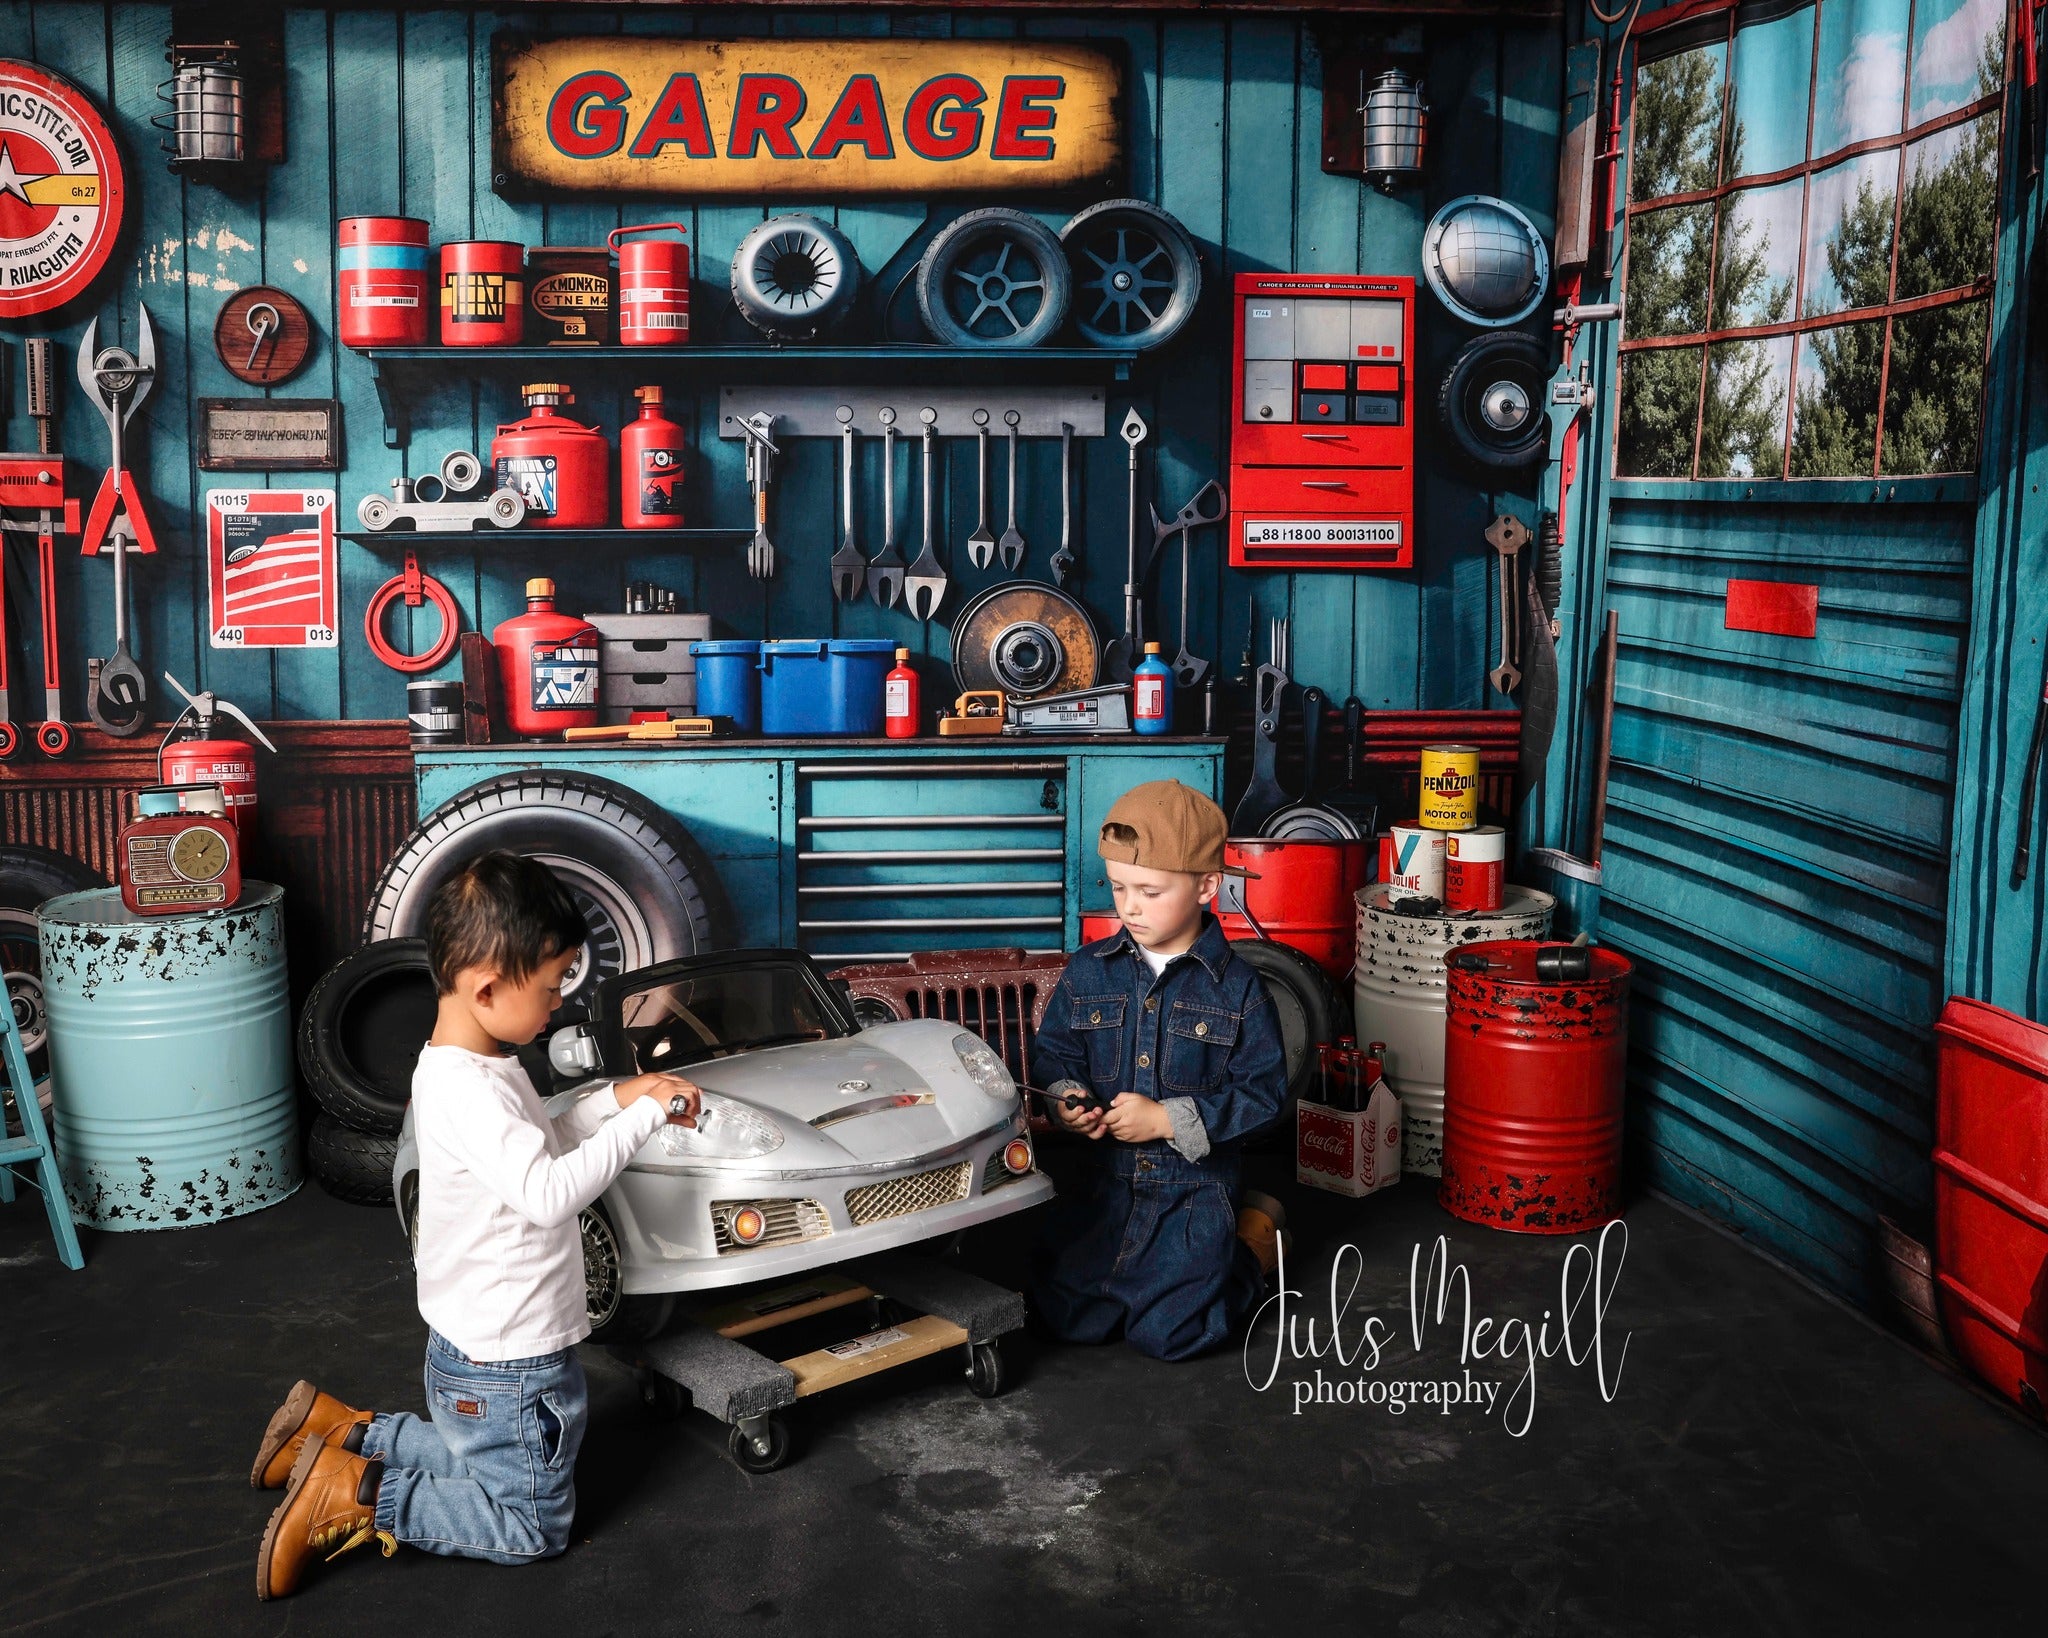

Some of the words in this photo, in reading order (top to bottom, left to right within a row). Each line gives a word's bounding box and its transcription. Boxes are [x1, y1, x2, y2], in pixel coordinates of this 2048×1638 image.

[546, 69, 1066, 162] GARAGE
[85, 187, 96, 197] 27
[214, 495, 248, 506] 11015
[306, 495, 325, 507] 80
[219, 629, 243, 642] 440
[310, 629, 333, 641] 013
[1423, 774, 1476, 791] PENNZOIL
[1424, 808, 1457, 820] MOTOR
[1460, 810, 1473, 820] OIL
